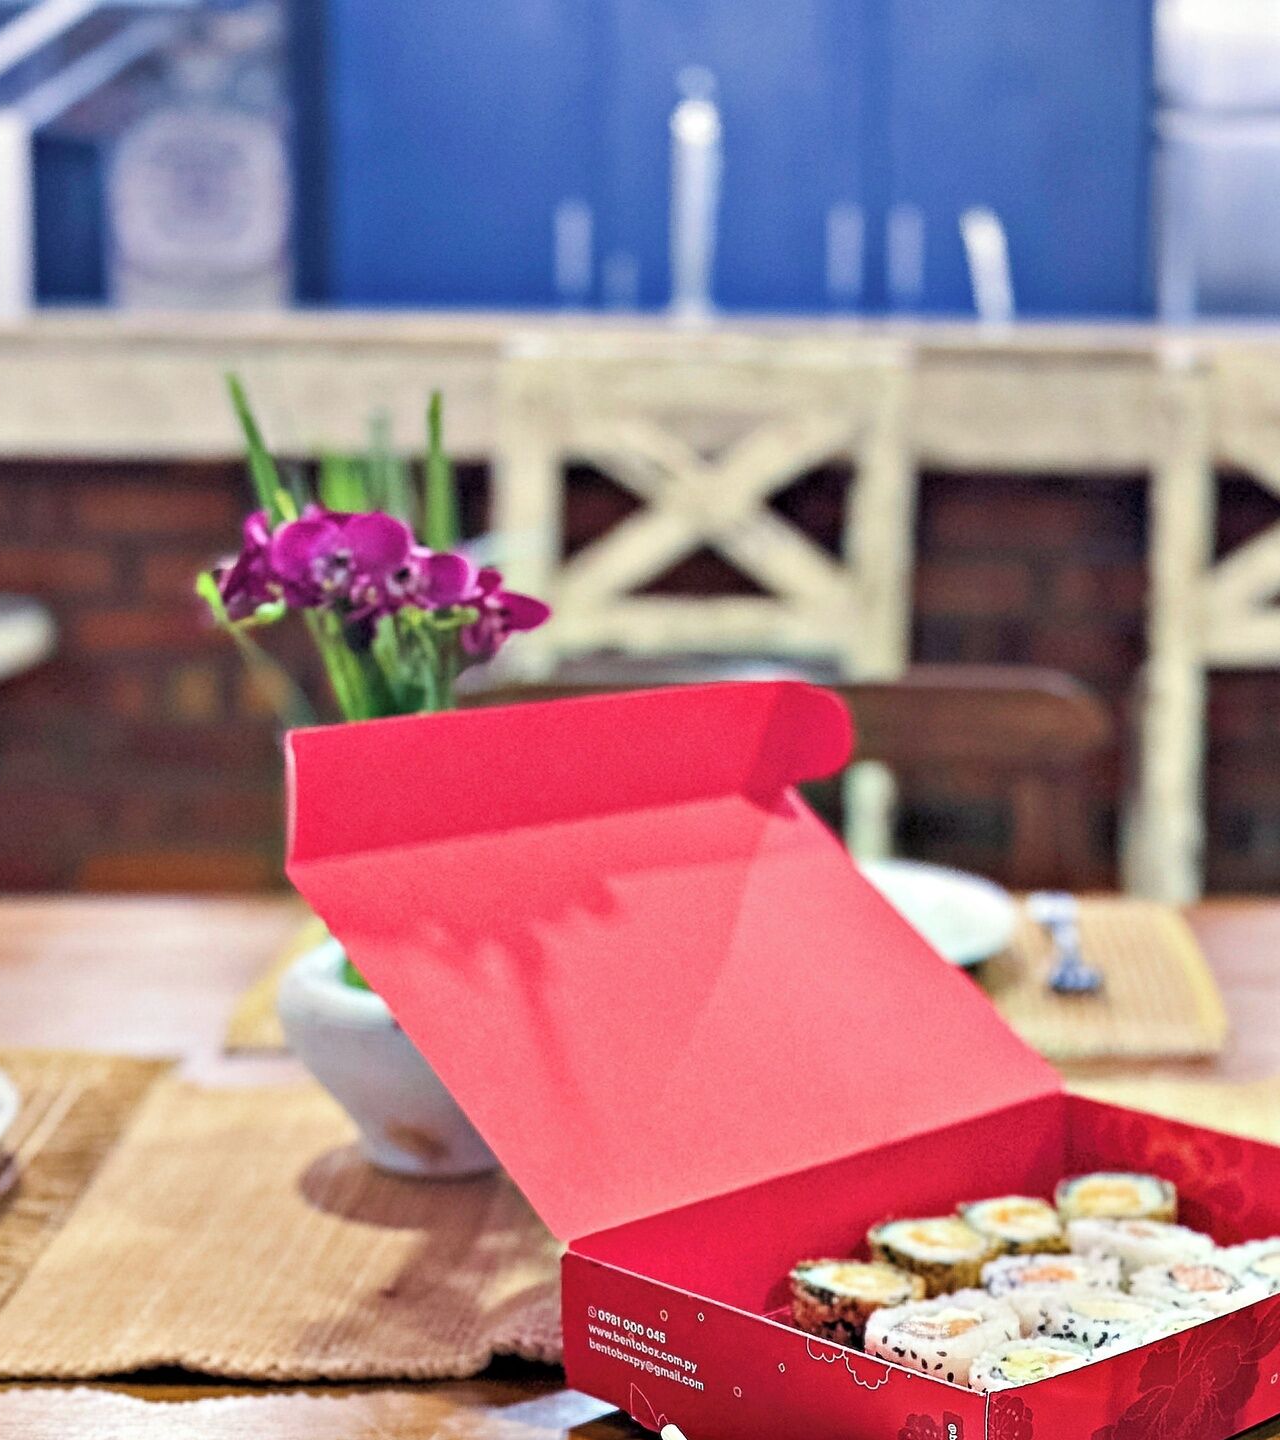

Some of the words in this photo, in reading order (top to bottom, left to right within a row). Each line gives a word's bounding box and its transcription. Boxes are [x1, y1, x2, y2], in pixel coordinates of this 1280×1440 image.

[588, 1323, 697, 1373] www.bentobox.com.py
[598, 1310, 621, 1327] 0981
[623, 1319, 644, 1336] 000
[646, 1328, 666, 1344] 045
[589, 1337, 704, 1391] bentoboxpy@gmail.com
